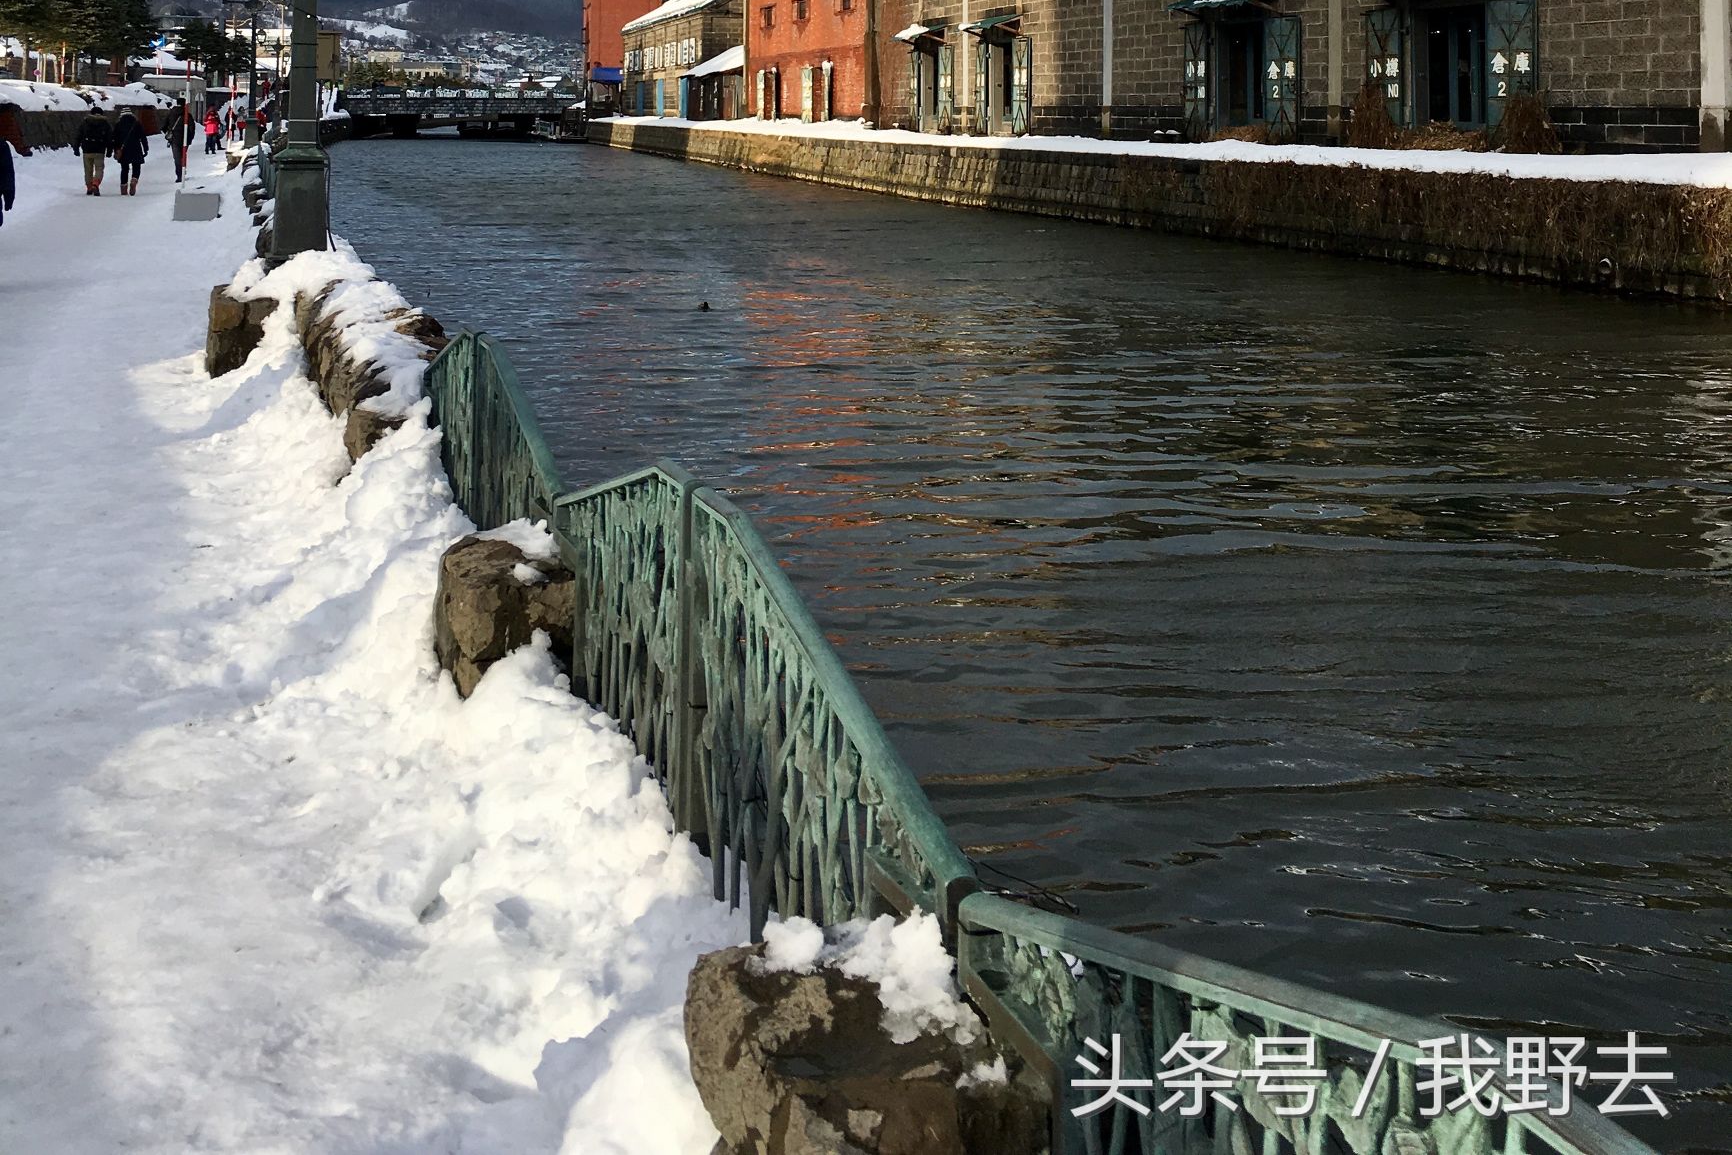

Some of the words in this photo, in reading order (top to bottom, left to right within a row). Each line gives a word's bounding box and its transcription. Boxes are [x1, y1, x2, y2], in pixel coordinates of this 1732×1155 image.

[1267, 60, 1296, 80] 倉庫
[1371, 57, 1399, 78] 小樽
[1490, 52, 1530, 74] 倉庫
[1272, 85, 1279, 98] 2
[1387, 83, 1399, 98] NO
[1497, 81, 1506, 97] 2
